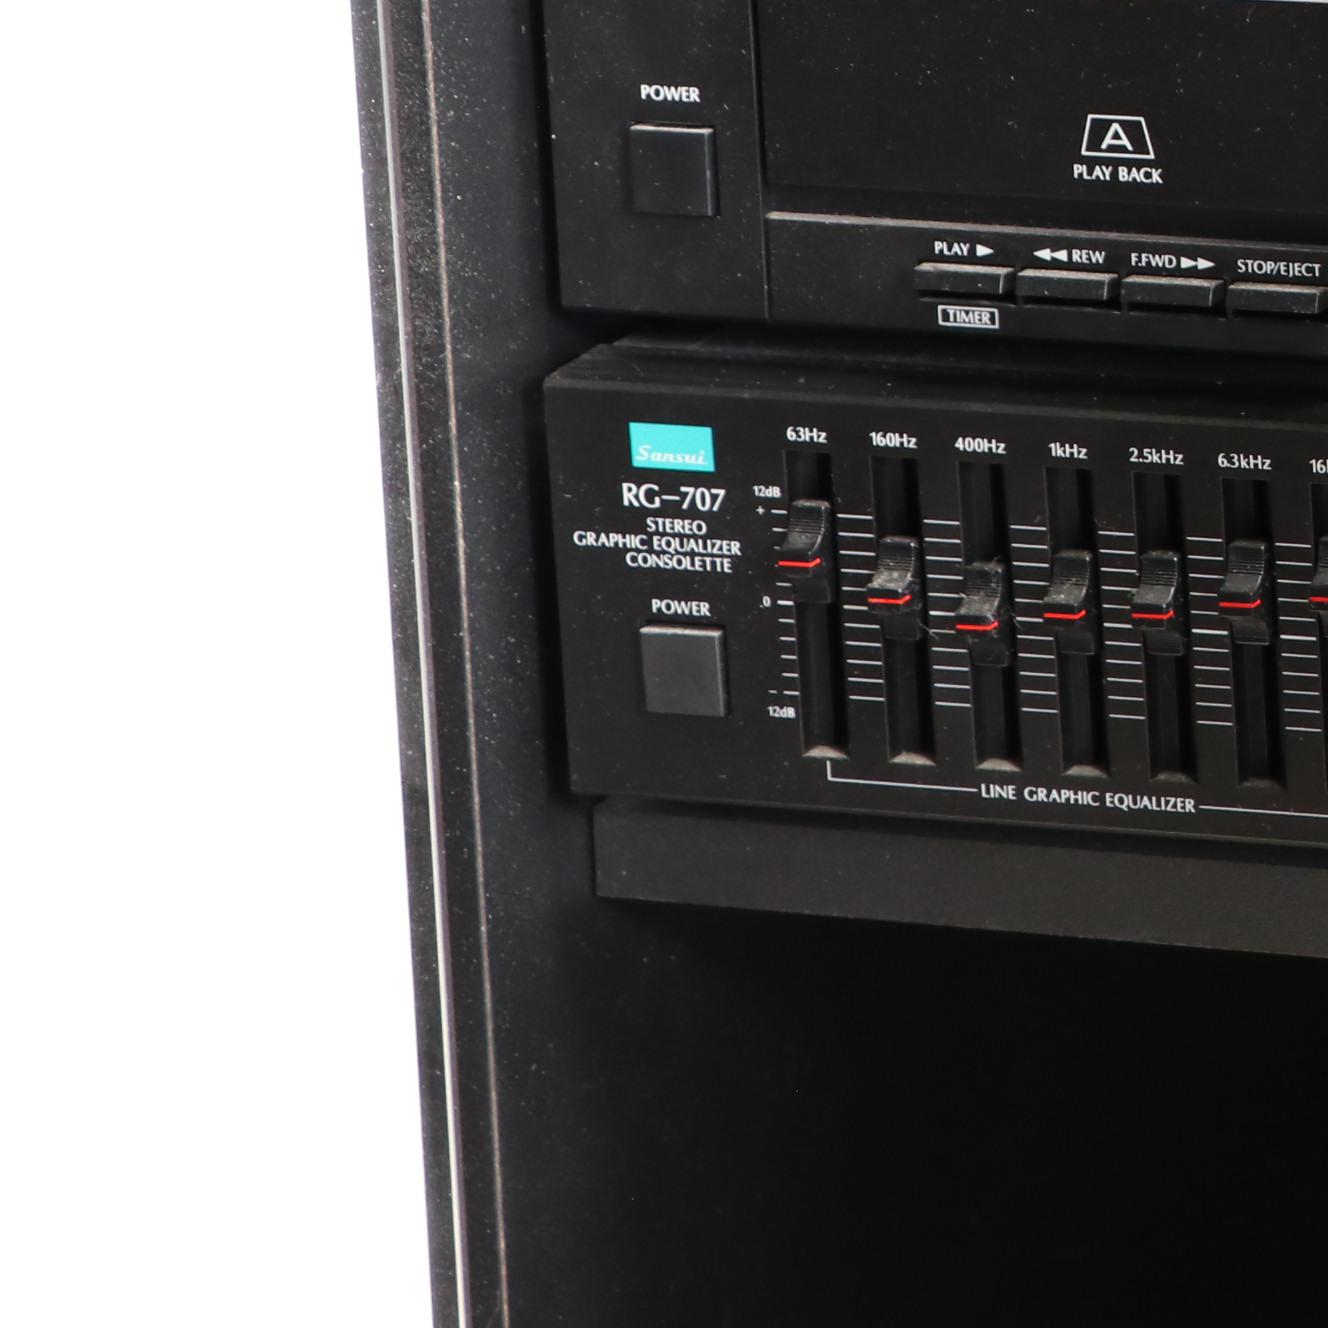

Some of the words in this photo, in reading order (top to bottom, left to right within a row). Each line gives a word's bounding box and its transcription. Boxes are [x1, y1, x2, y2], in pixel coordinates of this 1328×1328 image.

[640, 83, 700, 104] POWER
[1102, 122, 1133, 150] A
[1073, 163, 1114, 182] PLAY
[1118, 164, 1163, 184] BACK
[934, 241, 970, 257] PLAY
[1072, 249, 1105, 265] REW
[1131, 252, 1177, 269] F.FWD
[1237, 259, 1321, 278] STOP/EJECT
[947, 309, 991, 325] TIMER
[786, 426, 827, 443] 63Hz
[869, 431, 918, 449] 160Hz
[954, 436, 1007, 454] 400Hz
[1048, 442, 1088, 460] 1kHz
[635, 445, 708, 466] Sansui
[1128, 446, 1184, 466] 2.5kHz
[1217, 452, 1272, 471] 6.3kHz
[621, 482, 726, 512] RG-707
[646, 517, 707, 535] STEREO
[573, 530, 649, 550] GRAPHIC
[653, 532, 741, 556] EQUALIZER
[625, 552, 732, 573] CONSOLETTE
[651, 598, 711, 617] POWER
[980, 783, 1017, 800] LINE
[1024, 786, 1100, 806] GRAPHIC
[1104, 791, 1196, 813] EQUALIZER
